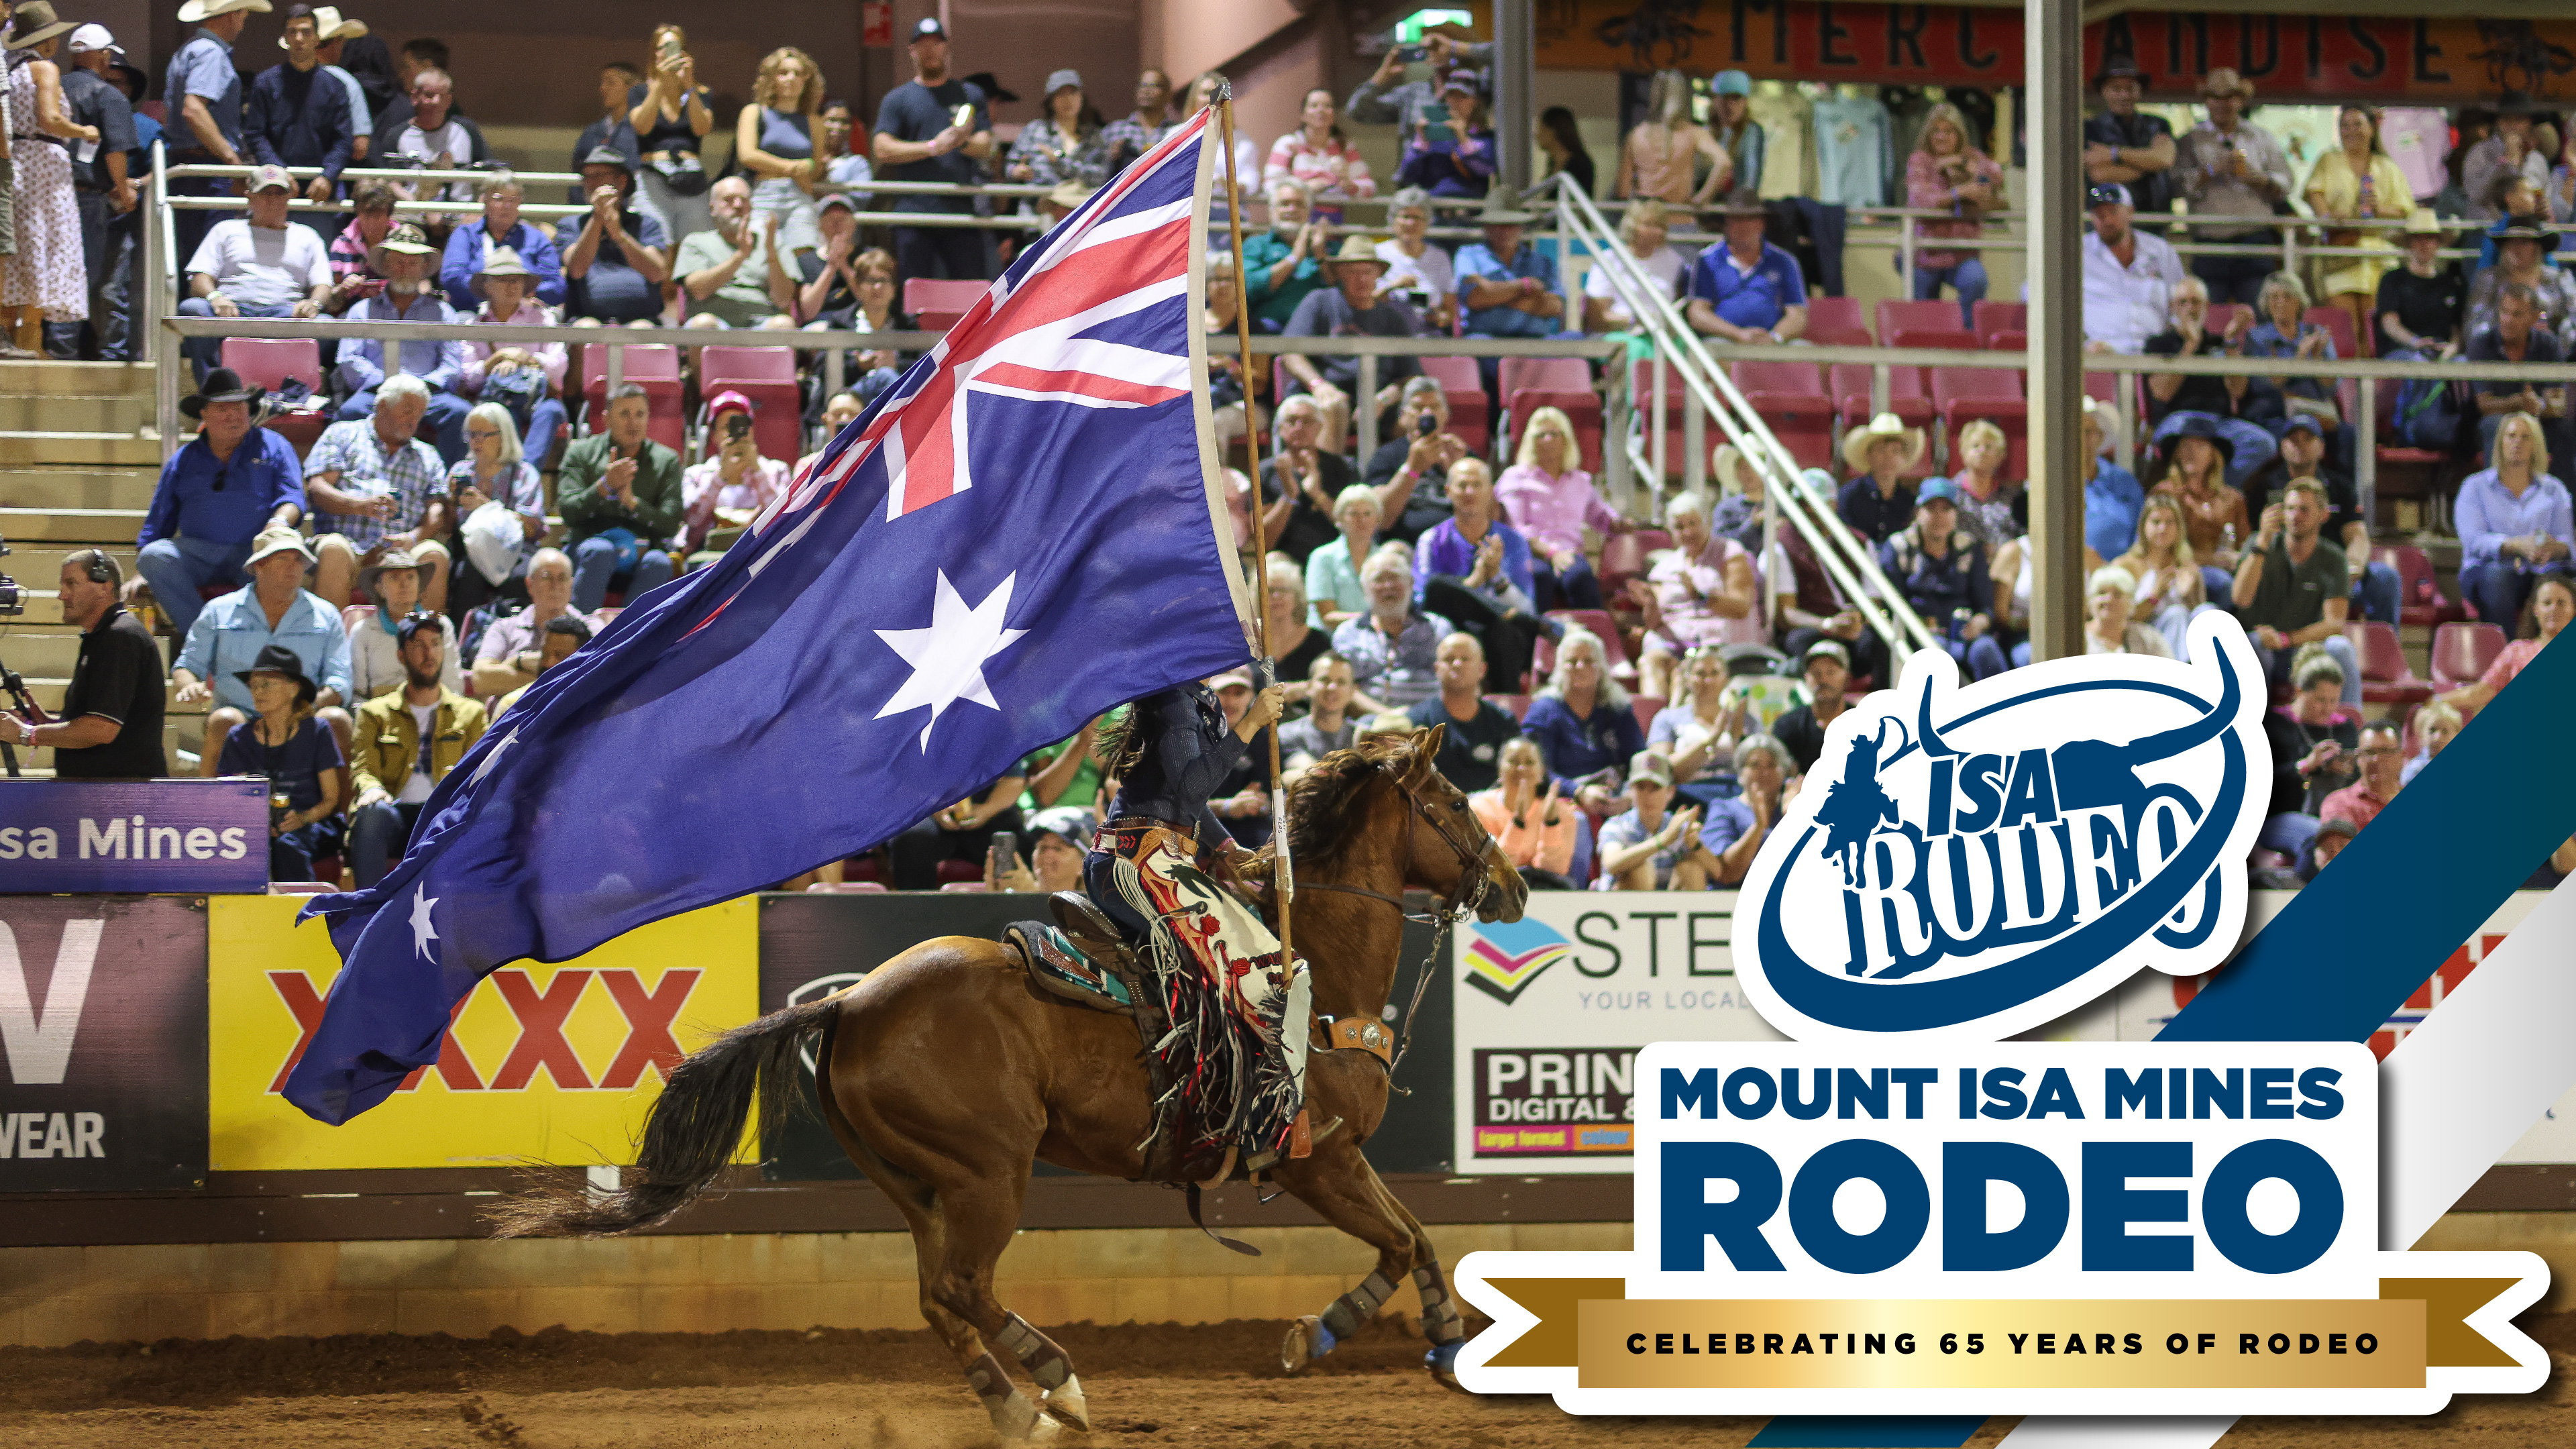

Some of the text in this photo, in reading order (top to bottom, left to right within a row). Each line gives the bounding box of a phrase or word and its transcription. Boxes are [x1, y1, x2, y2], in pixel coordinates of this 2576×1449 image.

[1731, 0, 2452, 83] MERCANDISE
[78, 814, 248, 860] Mines
[1579, 991, 1652, 1010] YOUR
[1487, 1053, 1637, 1097] PRIN
[1489, 1097, 1616, 1122] DIGITAL
